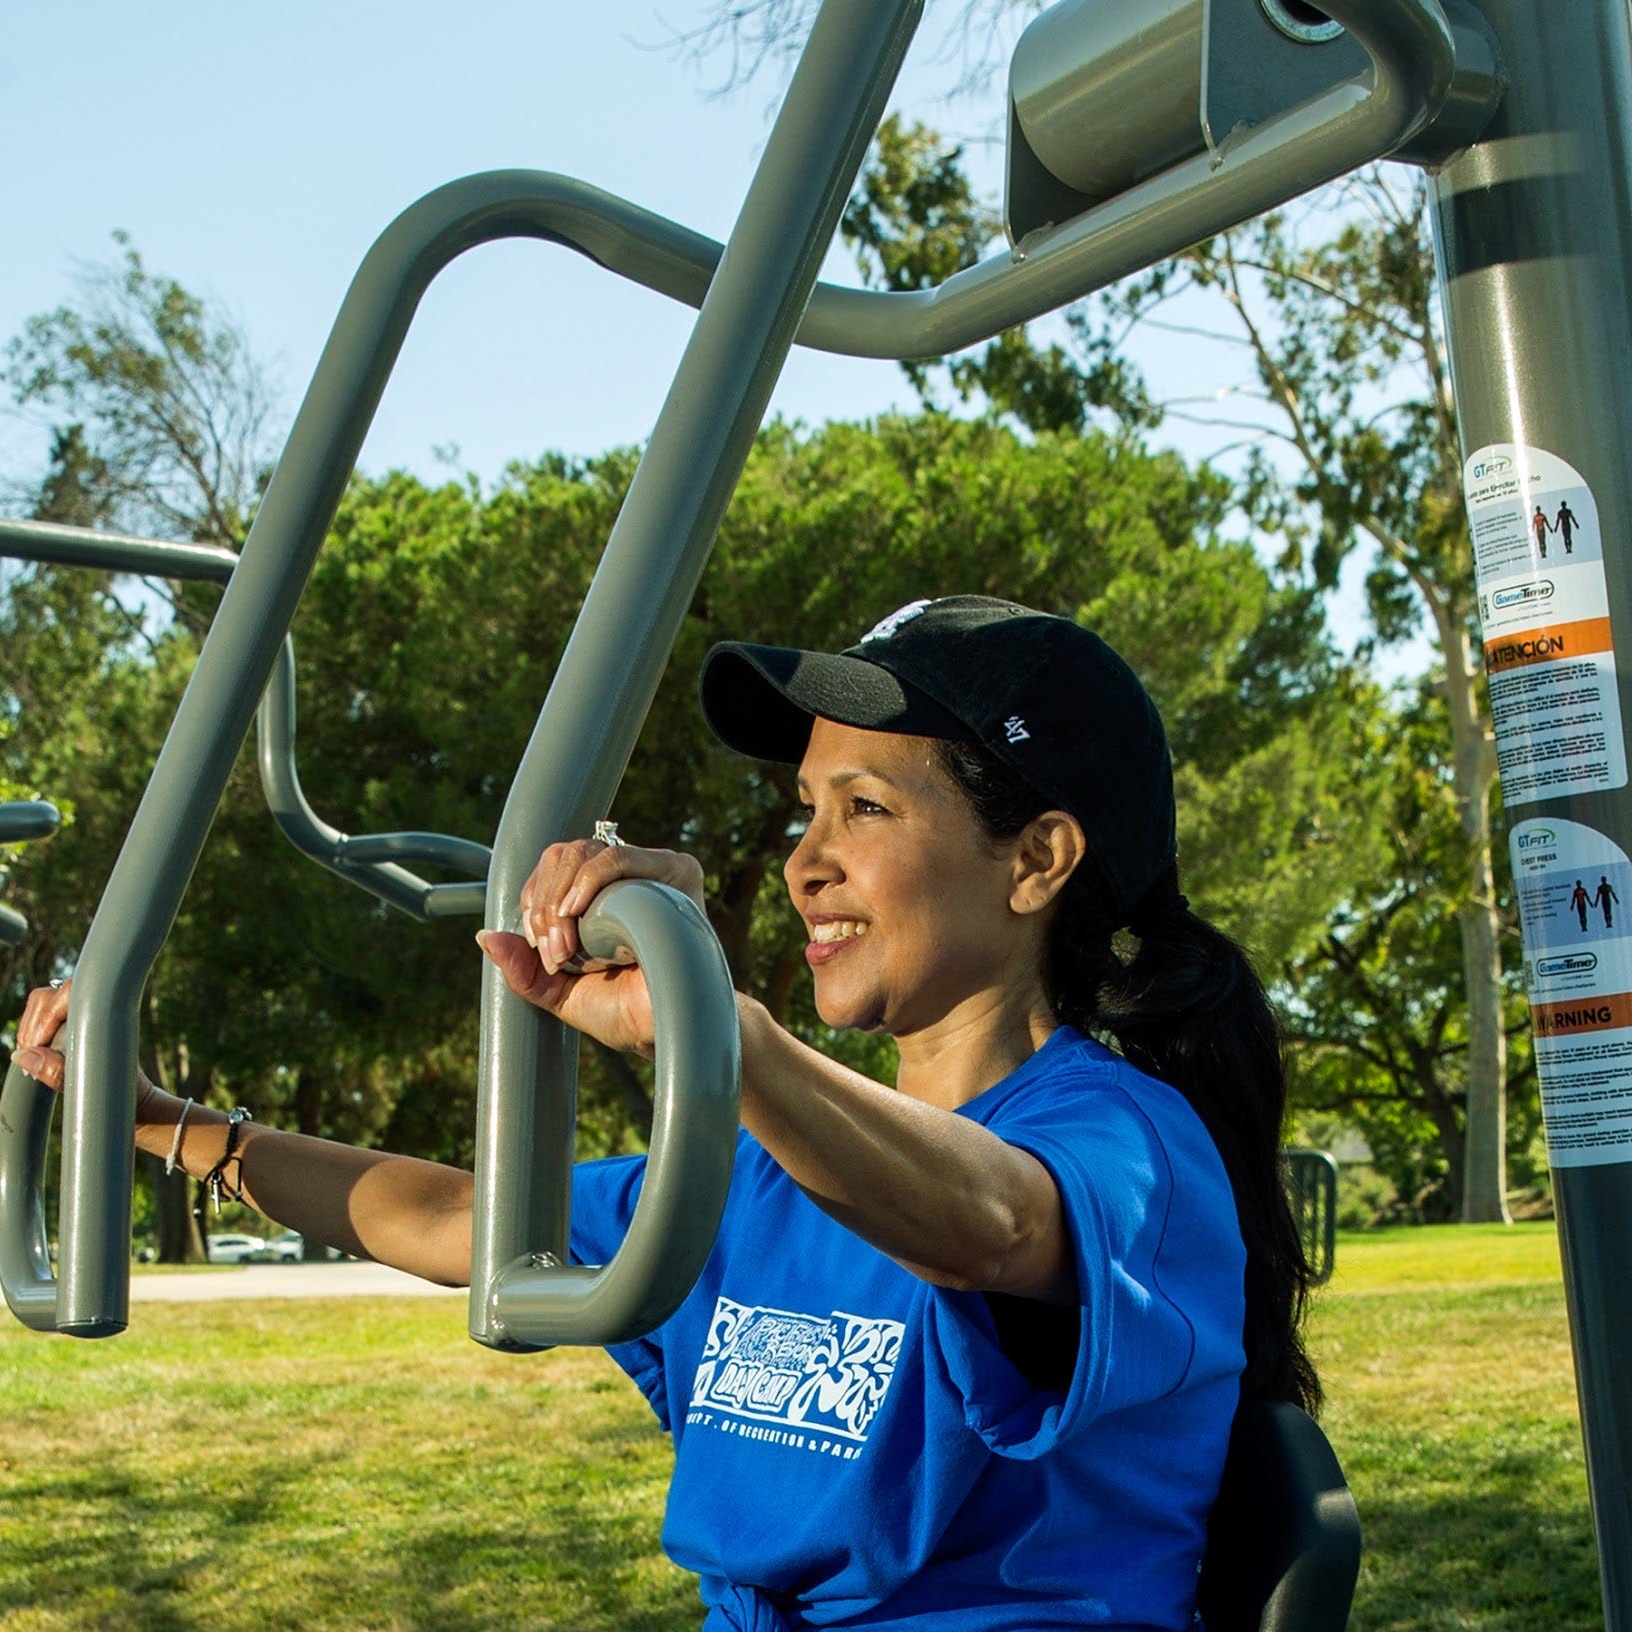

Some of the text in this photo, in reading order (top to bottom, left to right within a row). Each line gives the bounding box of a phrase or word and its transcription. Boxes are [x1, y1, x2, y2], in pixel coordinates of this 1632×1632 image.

[1540, 958, 1593, 973] GameTime
[714, 1361, 761, 1405] DAY
[721, 1419, 738, 1434] OF
[738, 1424, 805, 1448] RECREATION
[808, 1439, 817, 1451] &
